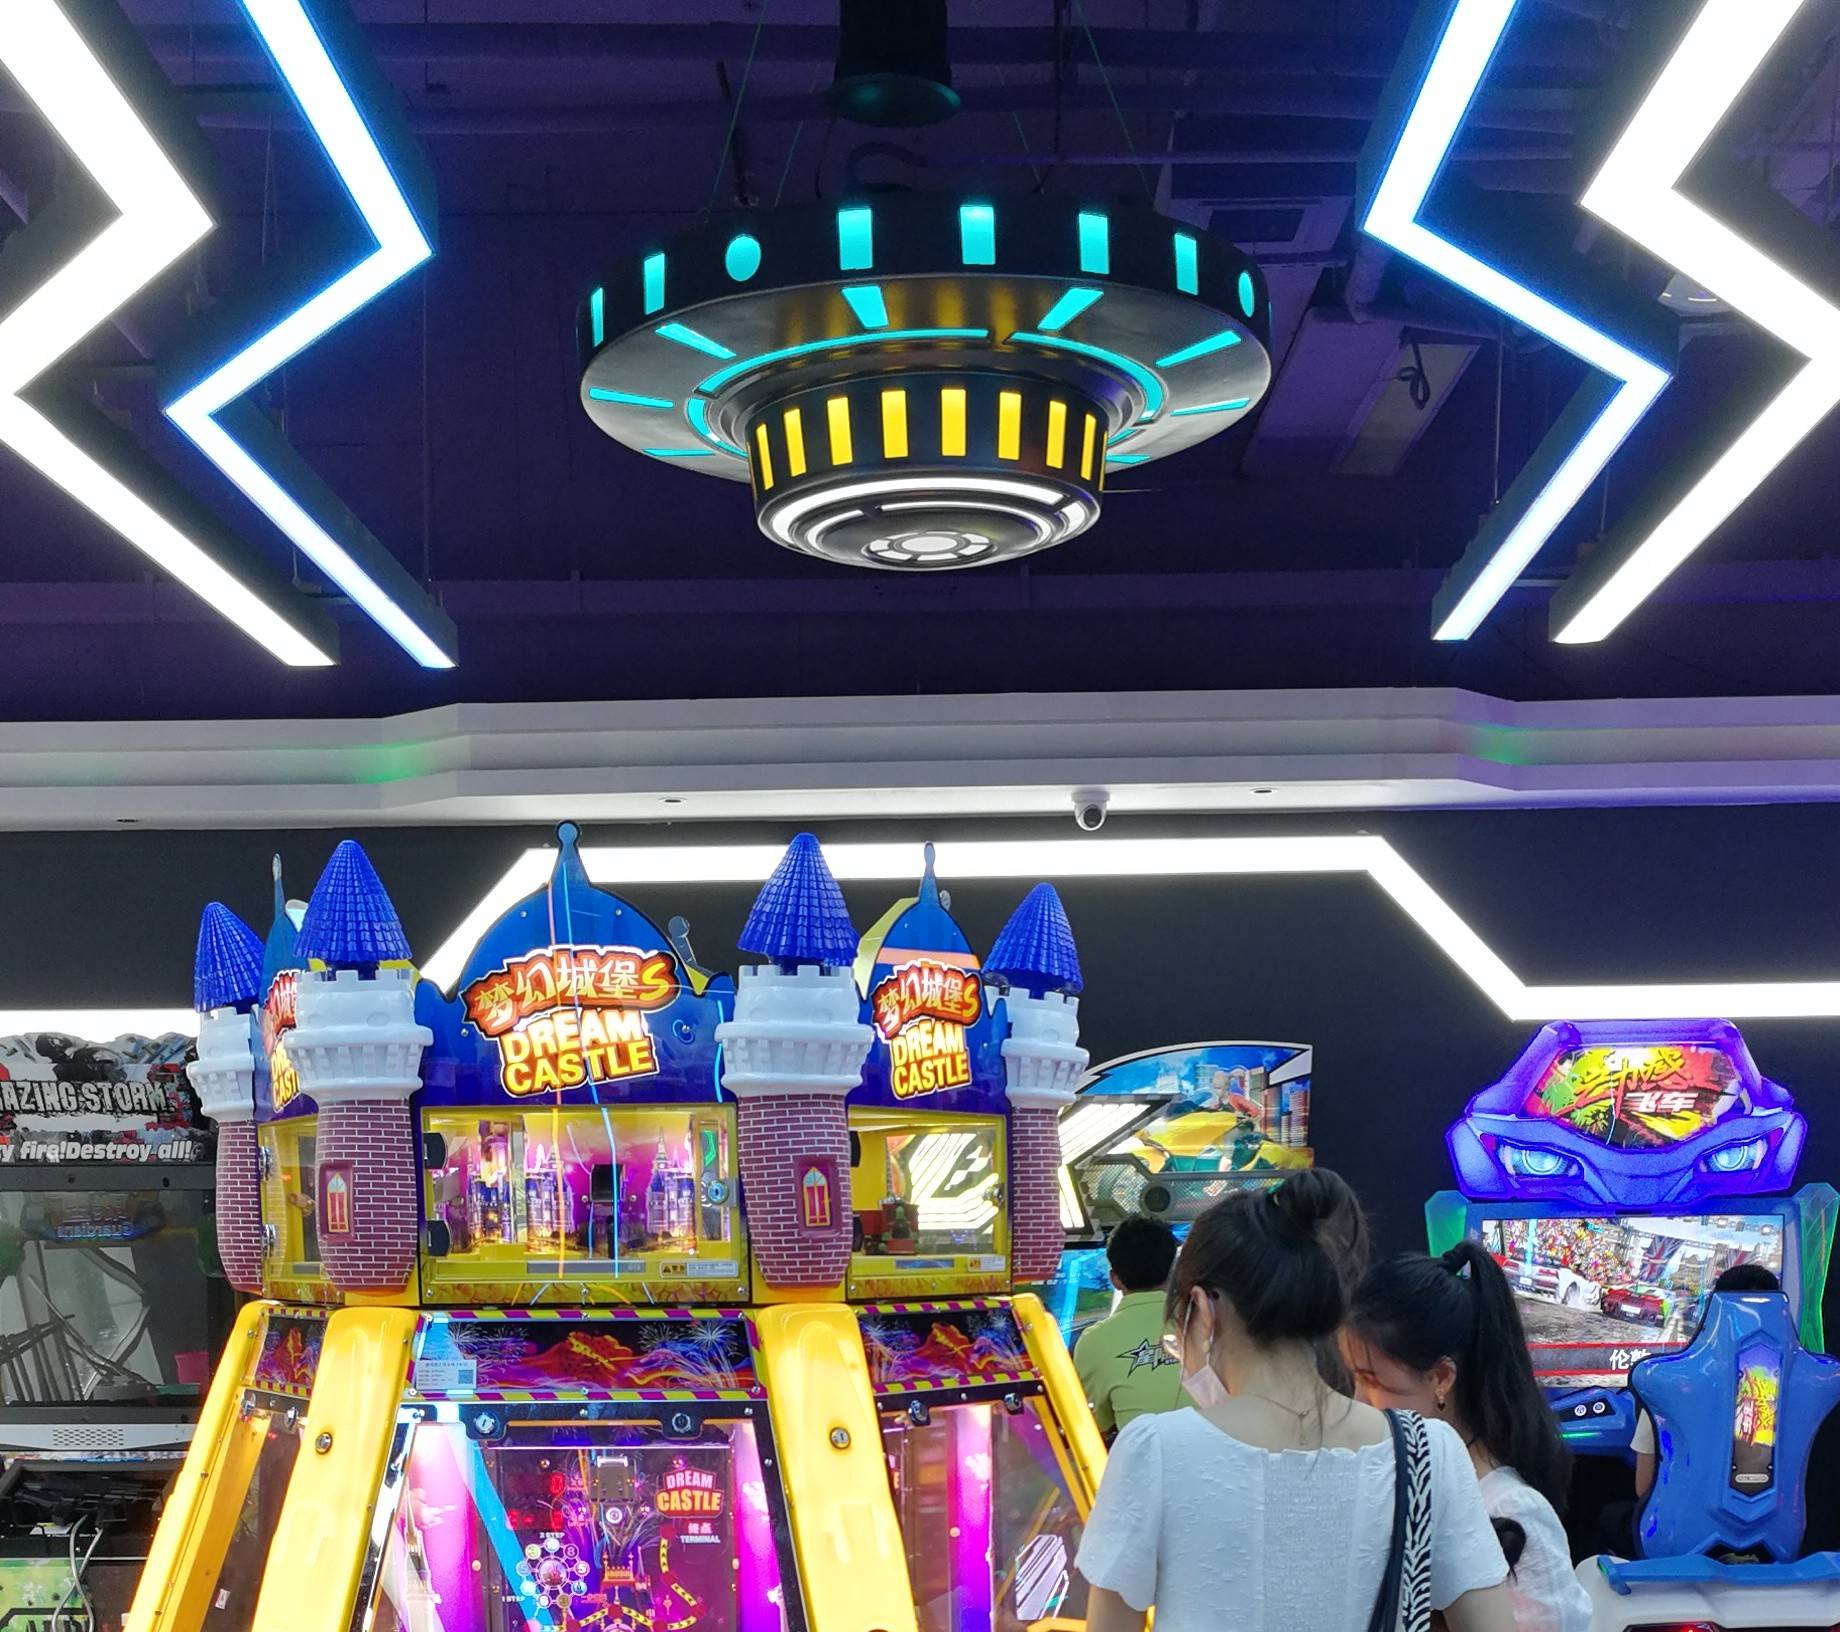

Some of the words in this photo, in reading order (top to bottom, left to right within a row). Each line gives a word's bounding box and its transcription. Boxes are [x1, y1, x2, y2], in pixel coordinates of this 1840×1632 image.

[476, 958, 668, 1022] 梦幻城堡S
[502, 1008, 643, 1062] DREAM
[892, 1020, 964, 1066] DREAM
[506, 1040, 653, 1092] CASTLE
[893, 1053, 969, 1095] CASTLE
[0, 1081, 78, 1112] AZING
[273, 1067, 300, 1108] CAST
[1624, 1092, 1699, 1113] 飞车
[0, 1144, 15, 1162] y
[158, 1140, 192, 1160] all!
[666, 1470, 714, 1489] DREAM
[656, 1488, 722, 1512] CASTLE
[680, 1535, 721, 1544] TERMINAL
